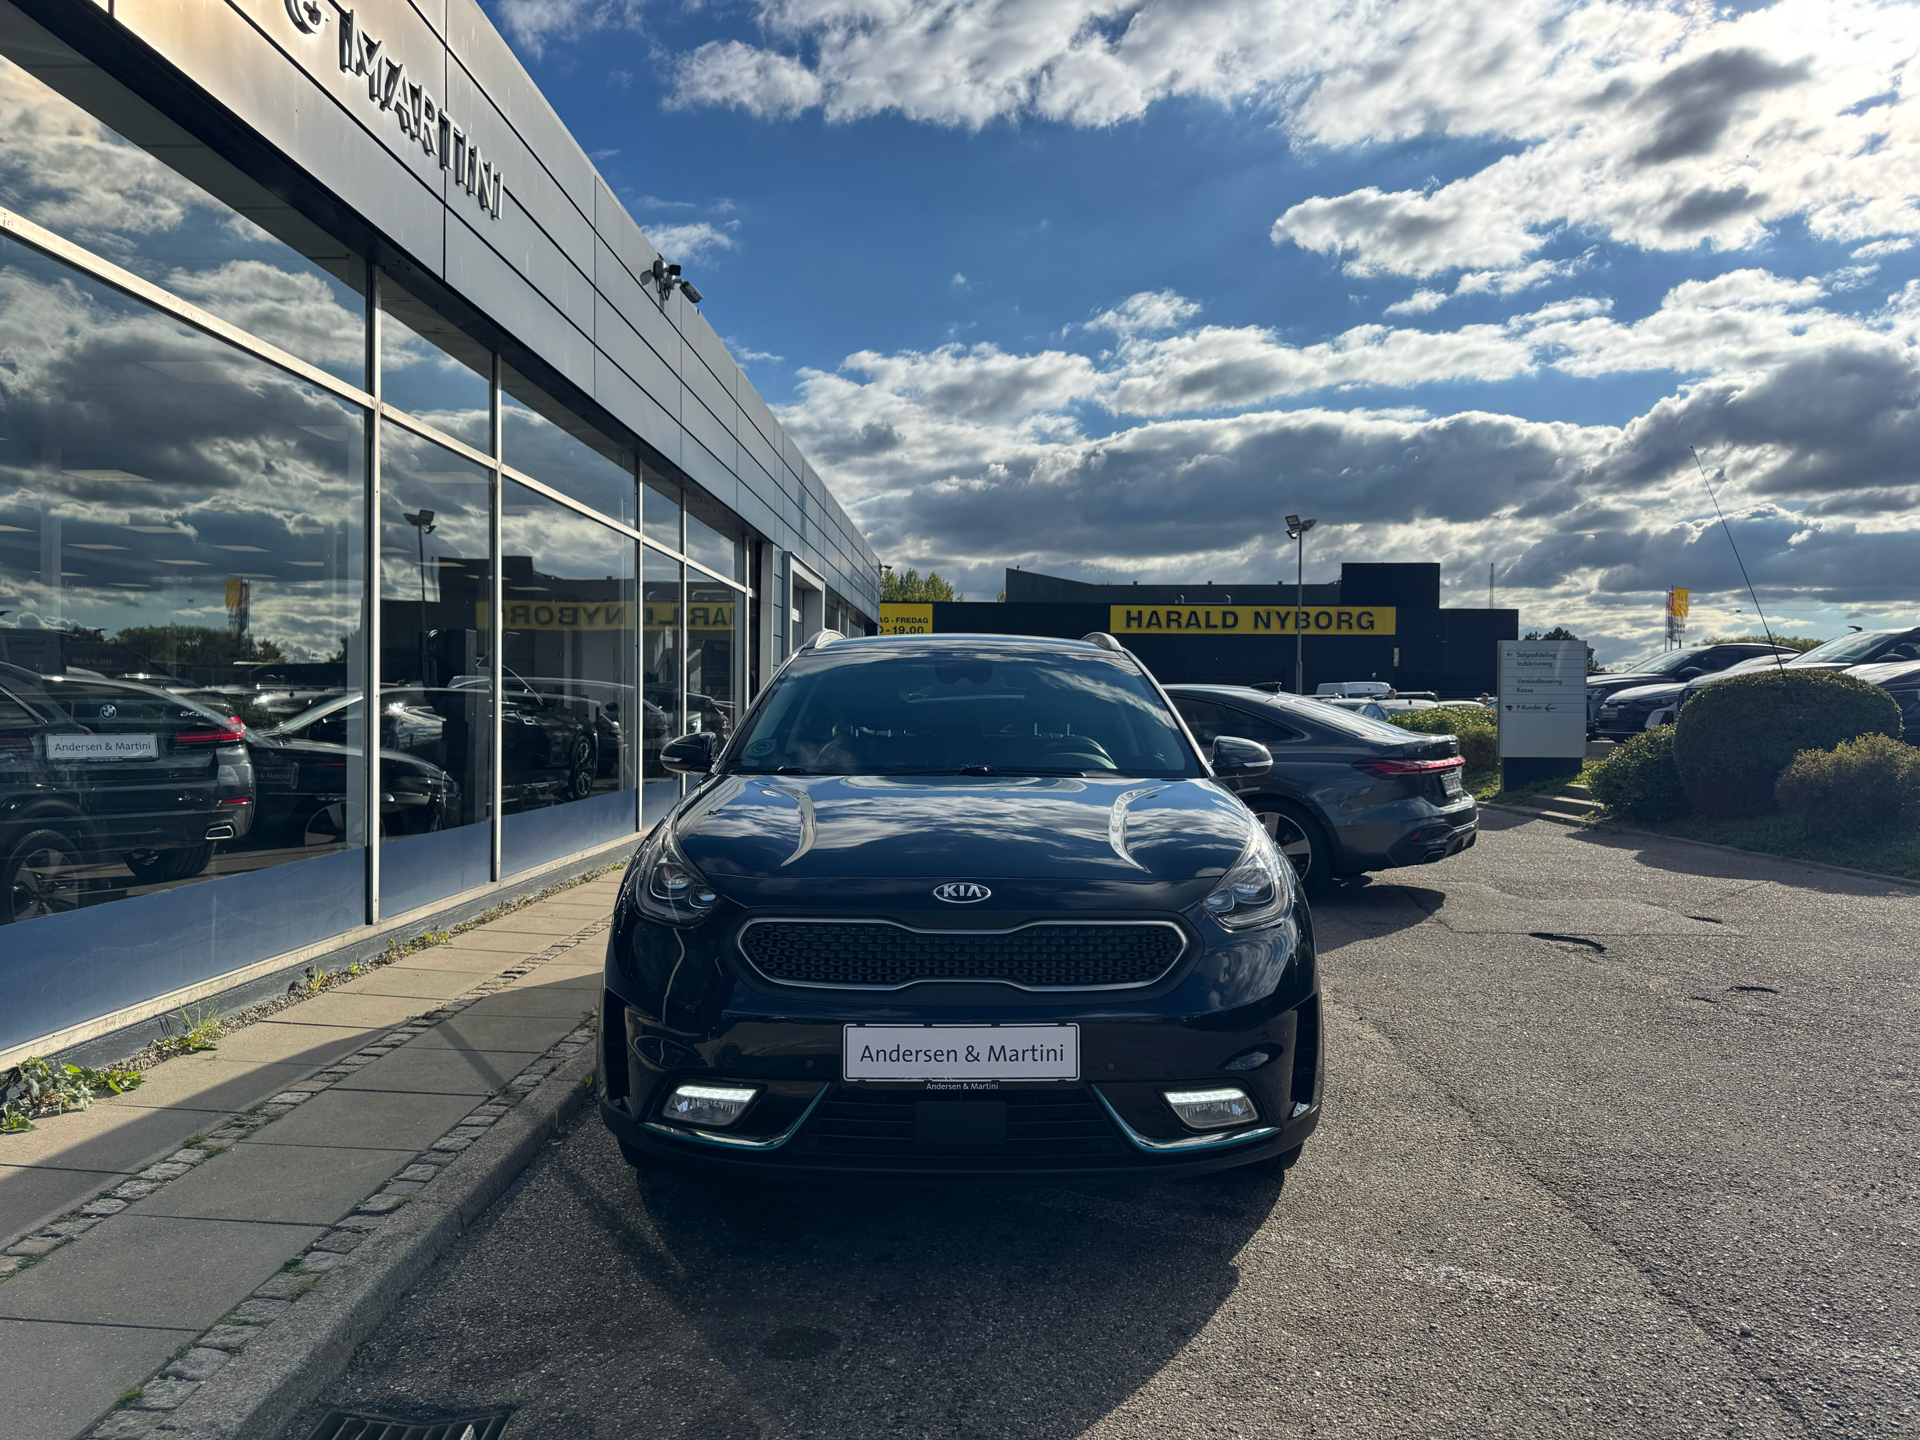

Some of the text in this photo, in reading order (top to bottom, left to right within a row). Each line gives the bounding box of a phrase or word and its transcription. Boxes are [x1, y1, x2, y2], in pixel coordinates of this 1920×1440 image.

[345, 9, 503, 220] MARTINI
[1125, 610, 1375, 631] HARALD NYBORG
[892, 625, 924, 634] 19.00
[54, 741, 151, 752] Andersen & Martini
[943, 885, 982, 898] KIA
[860, 1044, 1065, 1063] Andersen & Martini
[926, 1082, 961, 1090] Andersen
[971, 1082, 999, 1090] Martini
